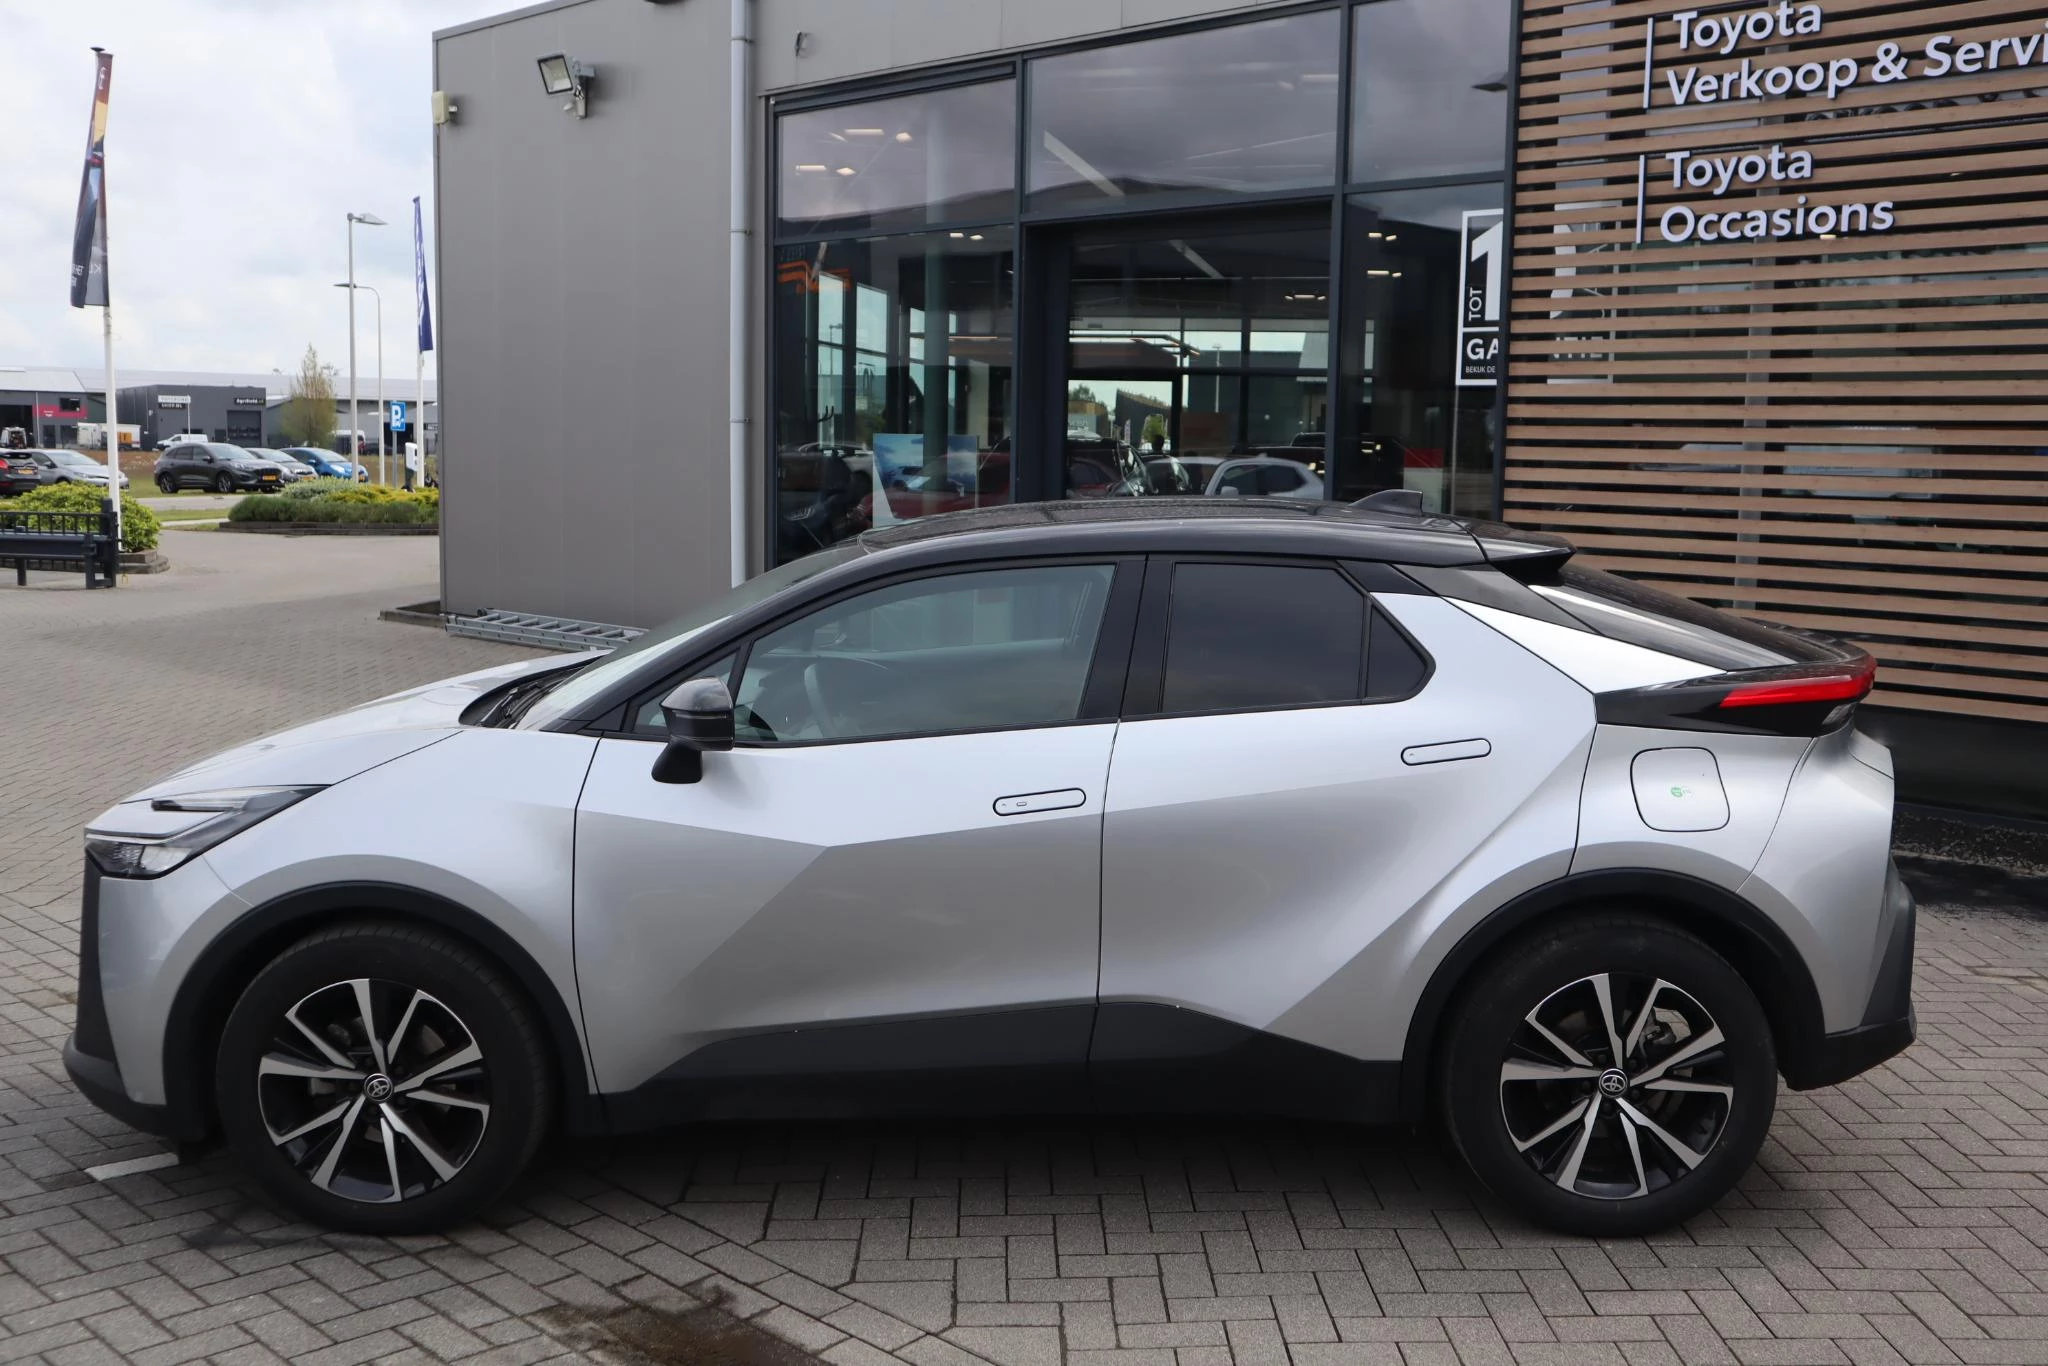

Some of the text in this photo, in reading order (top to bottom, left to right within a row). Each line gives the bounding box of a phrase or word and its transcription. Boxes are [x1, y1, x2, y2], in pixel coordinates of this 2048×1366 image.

[1673, 1, 1824, 55] Toyota
[1666, 57, 1859, 105] Verkoop
[1871, 42, 1909, 83] &
[1664, 144, 1814, 196] Toyota
[1659, 195, 1895, 243] Occasions
[1469, 287, 1483, 322] TOT
